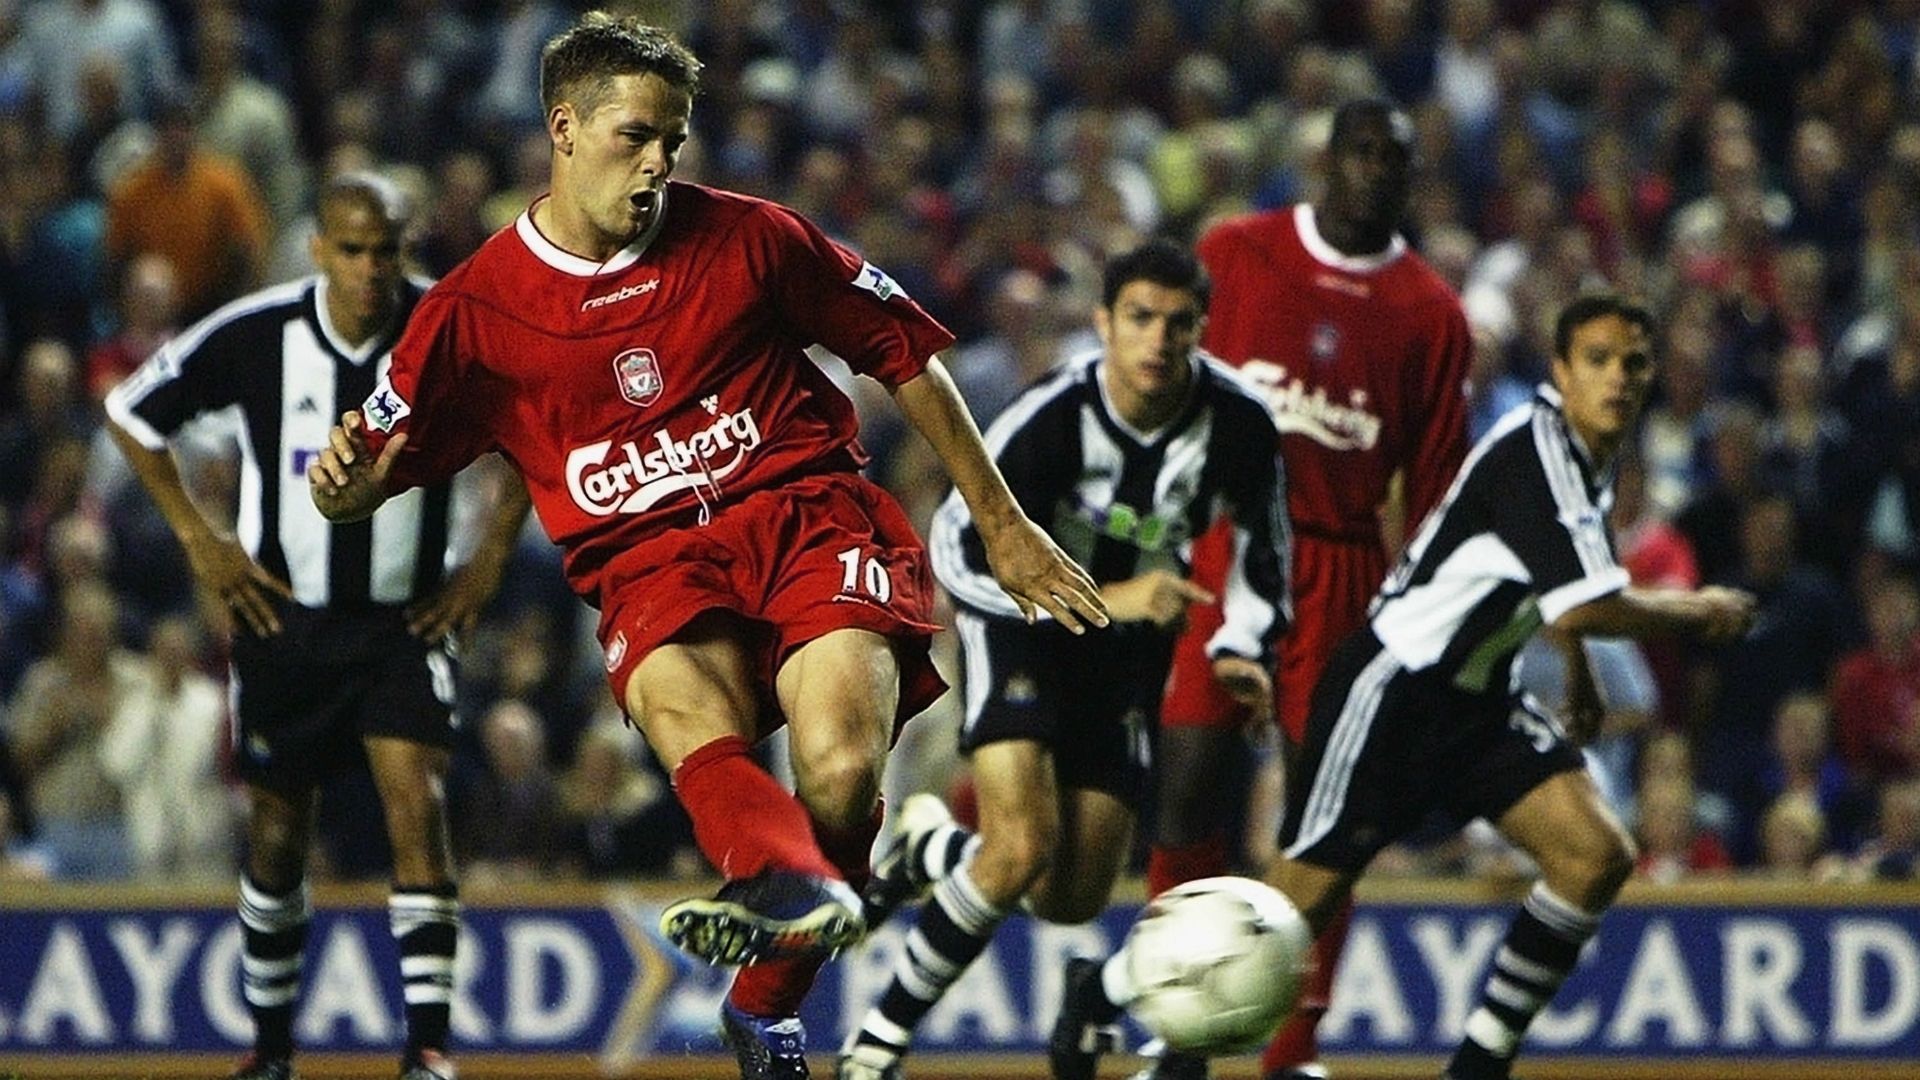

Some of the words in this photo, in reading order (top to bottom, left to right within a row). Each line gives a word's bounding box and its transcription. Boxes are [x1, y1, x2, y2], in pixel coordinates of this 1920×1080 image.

[581, 279, 660, 312] reebok
[565, 408, 762, 517] Carlsberg
[836, 546, 891, 604] 10
[0, 918, 602, 1046] AYCARD
[780, 1039, 797, 1050] 10
